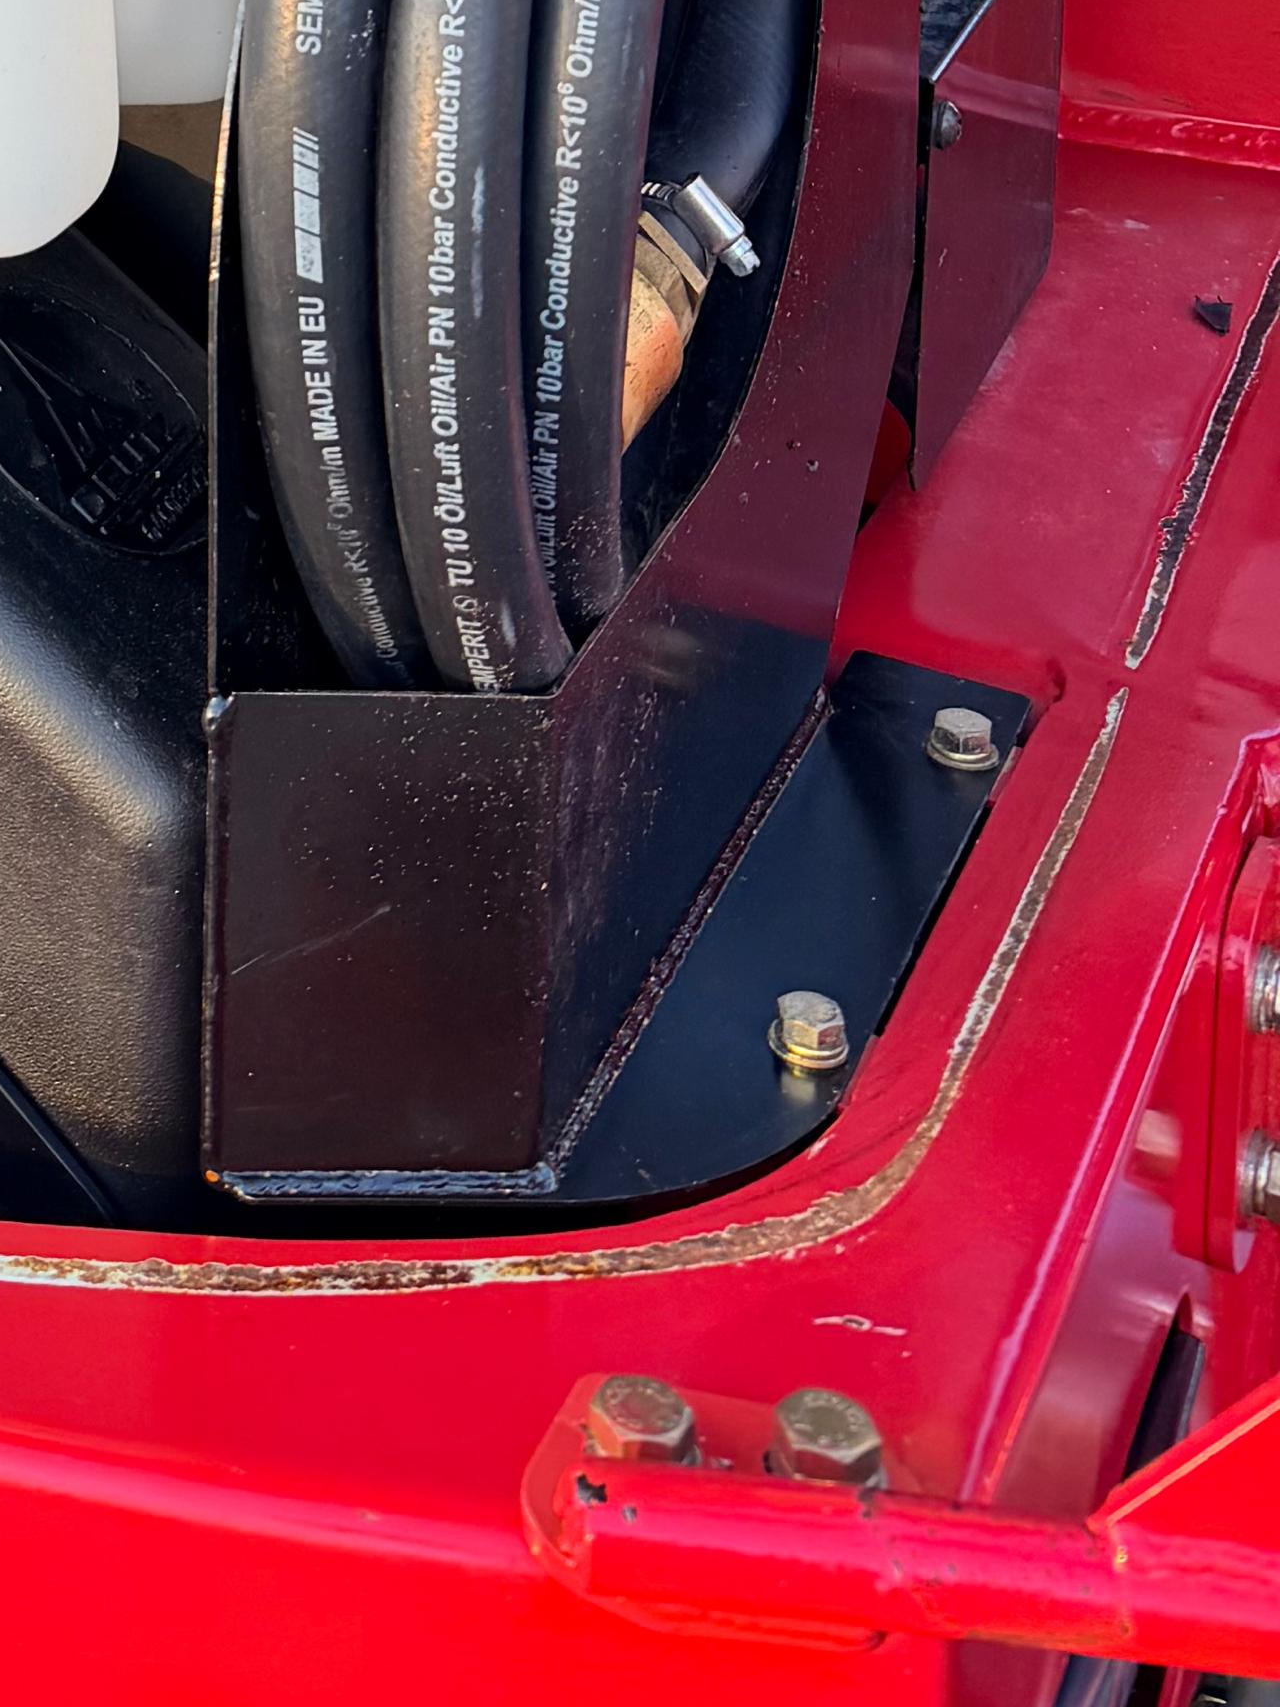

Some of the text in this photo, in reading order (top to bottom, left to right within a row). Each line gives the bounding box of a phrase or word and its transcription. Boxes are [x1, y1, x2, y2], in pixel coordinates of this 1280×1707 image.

[428, 44, 465, 211] Conductive
[428, 216, 456, 297] 10bar
[539, 176, 580, 331] Conductive
[298, 296, 326, 332] EU
[428, 306, 456, 348] PN
[301, 340, 329, 364] IN
[535, 334, 564, 403] 10bar
[304, 371, 340, 441] MADE
[429, 352, 460, 437] Oil/Air
[533, 410, 560, 445] PN
[320, 445, 354, 519] Ohm/m
[433, 441, 466, 524] Öl/Luft
[442, 527, 470, 554] 10
[446, 558, 476, 587] TU
[456, 615, 500, 693] EMPERIT
